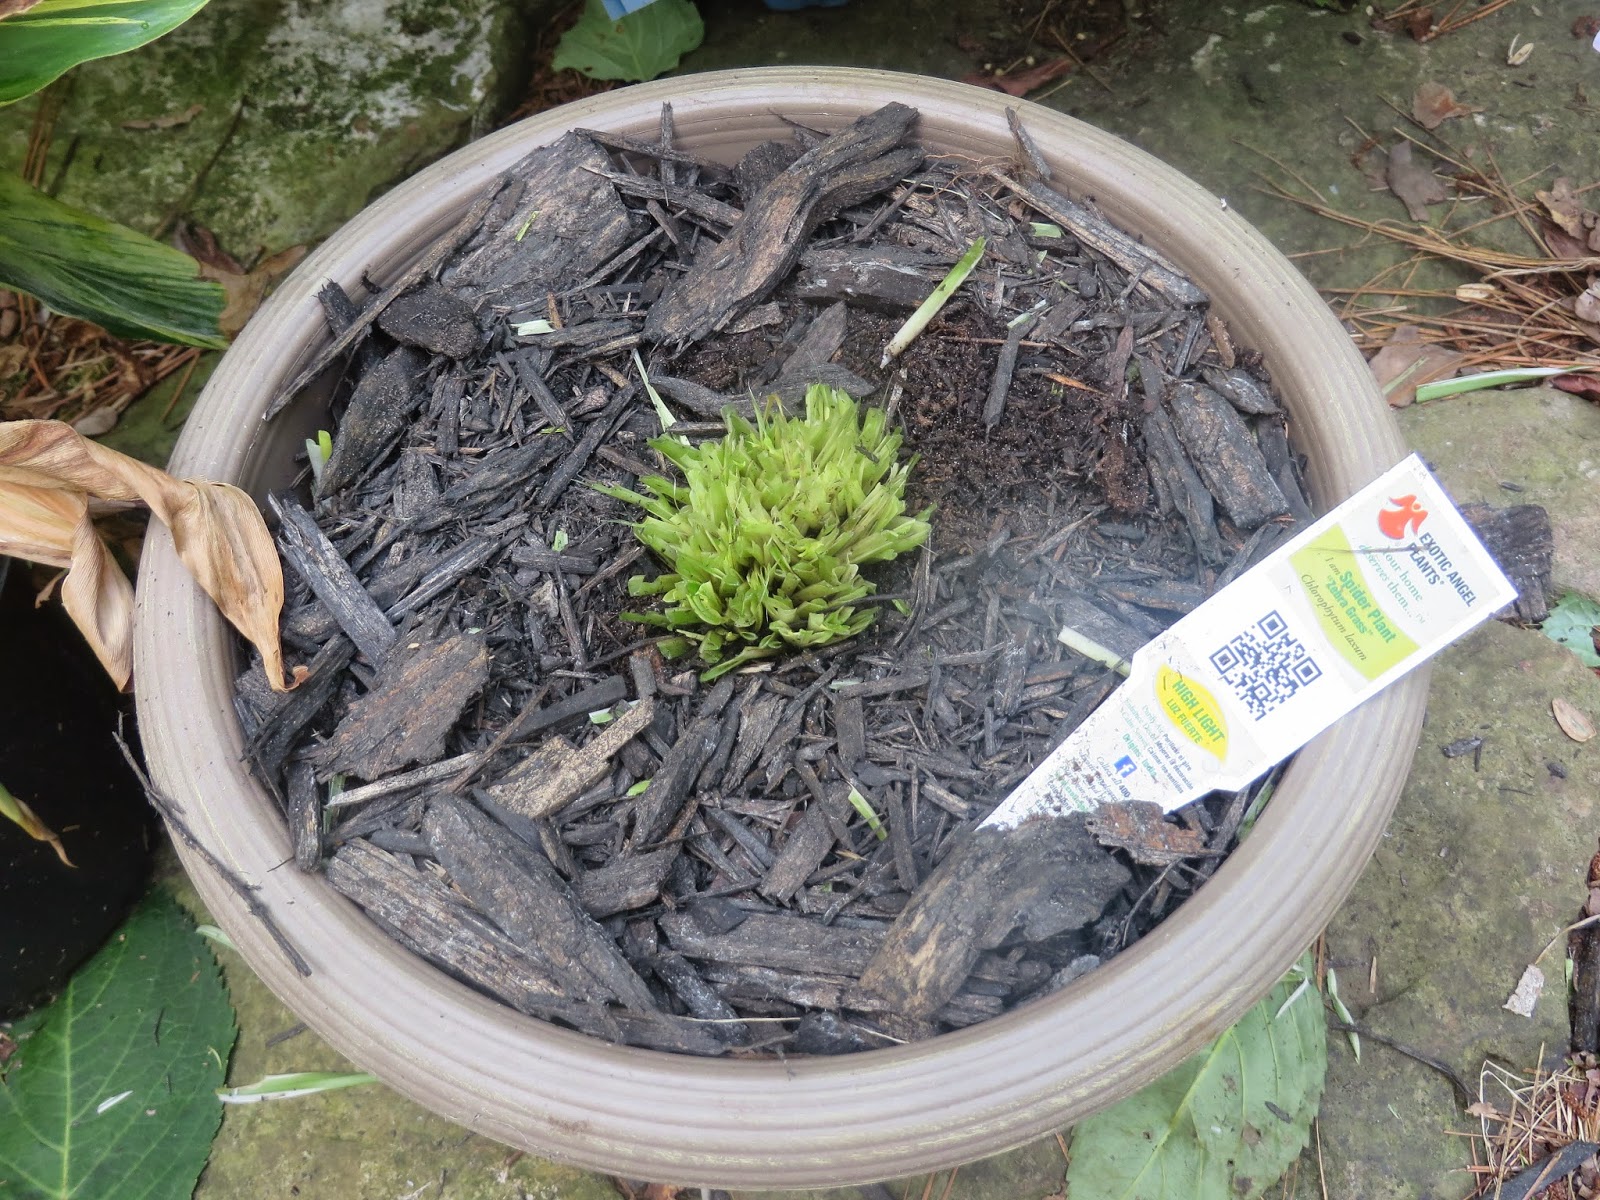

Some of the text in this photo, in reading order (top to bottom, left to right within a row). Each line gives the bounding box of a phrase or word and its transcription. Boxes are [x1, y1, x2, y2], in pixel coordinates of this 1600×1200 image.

[1397, 569, 1427, 602] home
[1417, 531, 1479, 607] EXOTIC ANGEL
[1296, 571, 1370, 661] Chlorophytum laxum
[1328, 561, 1341, 576] am
[1335, 569, 1374, 612] Spider
[1365, 608, 1398, 644] Plant
[1165, 698, 1203, 744] LUZ FUERTE
[1170, 678, 1225, 744] HIGH LIGHT
[1120, 732, 1145, 761] Origins:
[1146, 745, 1163, 765] Calmar
[1117, 783, 1131, 799] 400
